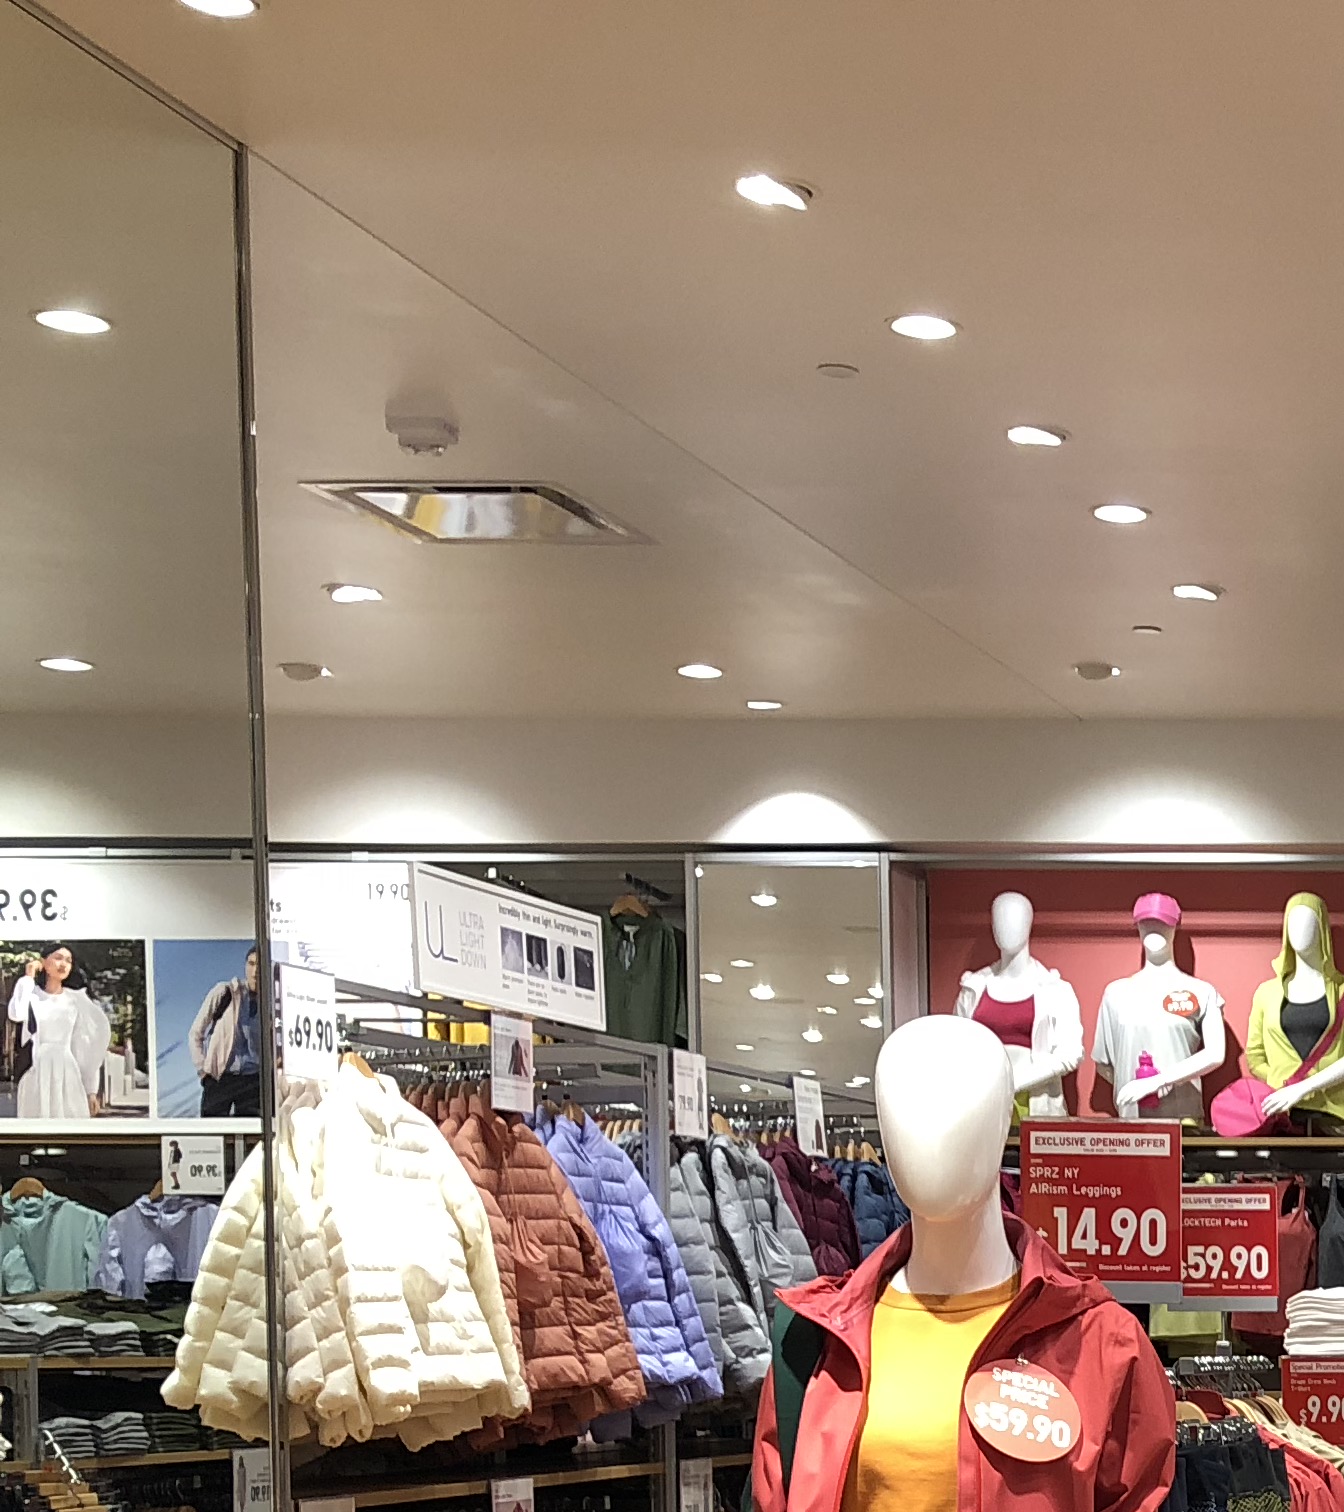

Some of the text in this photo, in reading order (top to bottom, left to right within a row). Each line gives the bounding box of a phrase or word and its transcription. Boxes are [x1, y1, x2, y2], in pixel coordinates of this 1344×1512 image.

[458, 911, 484, 930] ULTRA
[498, 903, 520, 921] Incredibly
[460, 930, 485, 949] LIGHT
[461, 949, 487, 969] DOWN
[289, 1014, 333, 1053] $69.90
[1034, 1136, 1166, 1148] EXCLUSIVE OPENING OFFER
[1029, 1167, 1080, 1178] SPRZ NY
[1029, 1183, 1122, 1198] AIRism Leggings
[1224, 1218, 1248, 1227] Parka
[992, 1367, 1060, 1398] SPECIAL
[974, 1401, 1071, 1448] $59.90
